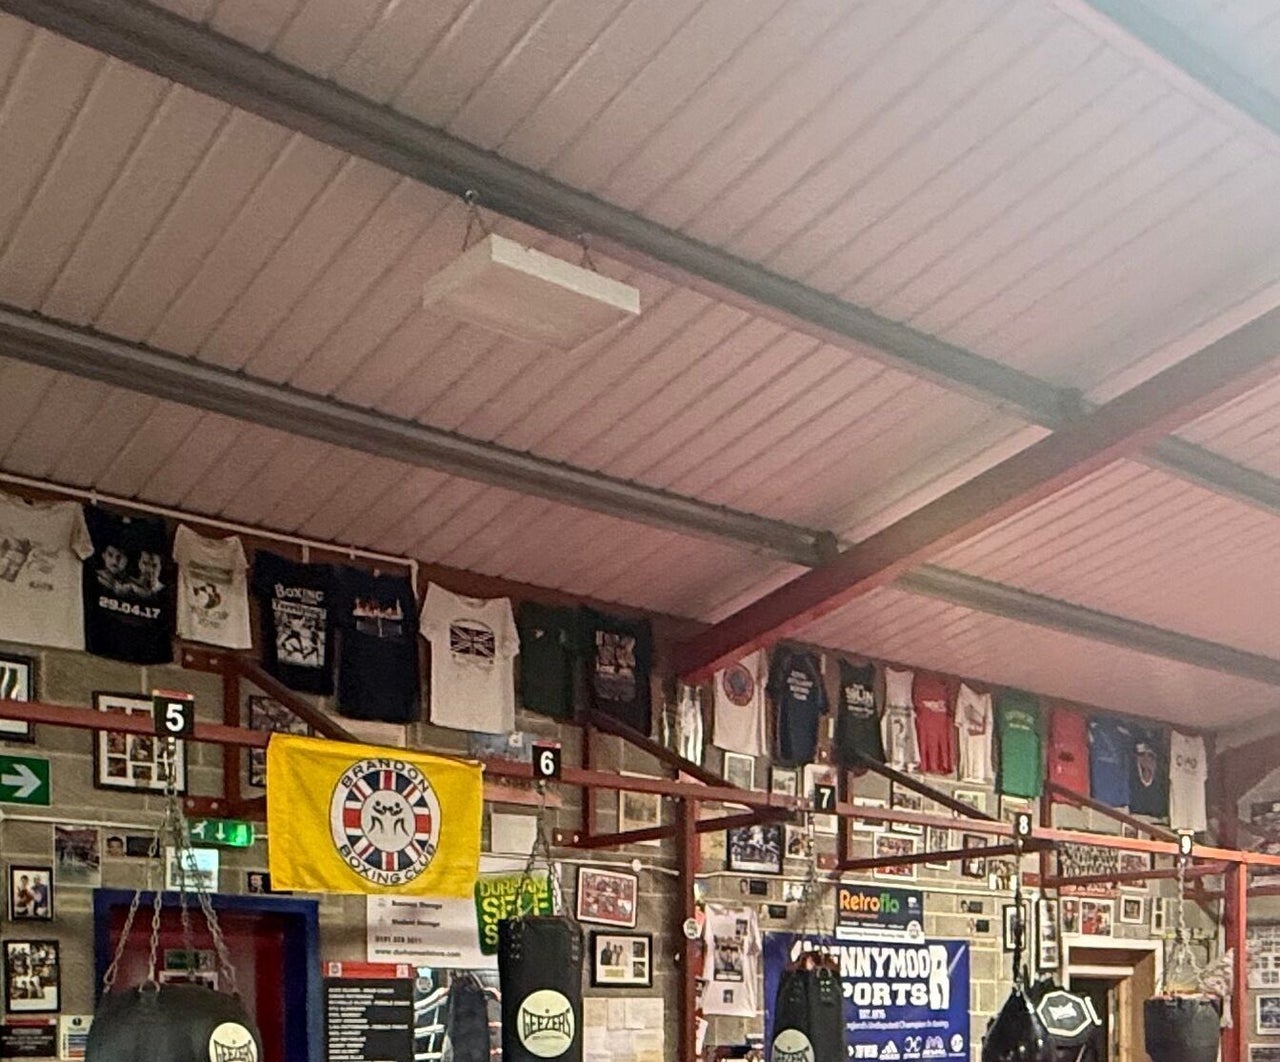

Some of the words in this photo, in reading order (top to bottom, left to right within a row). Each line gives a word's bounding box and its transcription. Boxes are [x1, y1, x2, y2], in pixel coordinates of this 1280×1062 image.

[98, 596, 161, 619] 29.04.17
[165, 703, 185, 733] 5
[540, 750, 555, 776] 6
[340, 758, 430, 793] BRANDON
[820, 789, 831, 808] 7
[1018, 816, 1029, 835] 8
[1181, 835, 1190, 854] 9
[339, 843, 402, 884] BOXING
[404, 843, 437, 882] CLUB
[839, 889, 900, 913] Retroflo
[842, 982, 929, 1006] PORTS
[522, 1007, 571, 1041] GEEZERS
